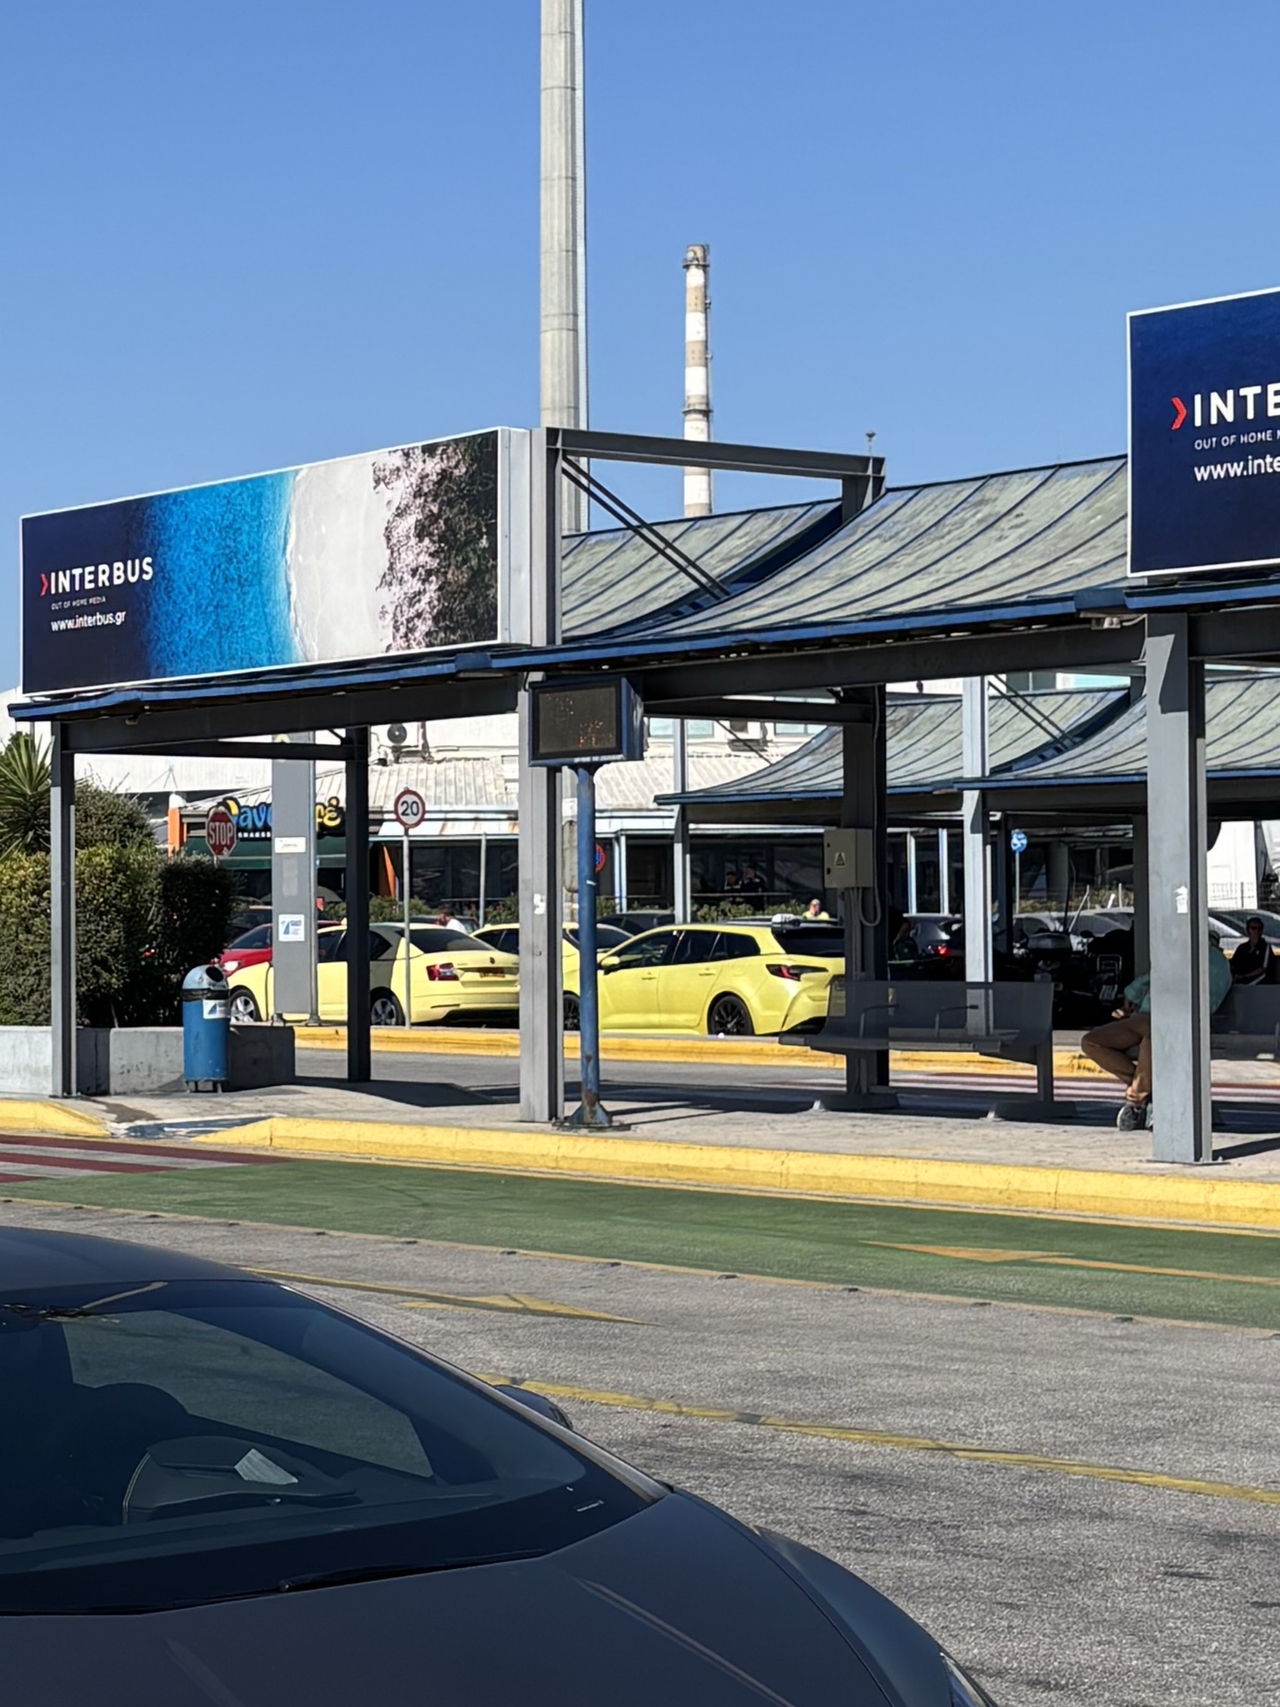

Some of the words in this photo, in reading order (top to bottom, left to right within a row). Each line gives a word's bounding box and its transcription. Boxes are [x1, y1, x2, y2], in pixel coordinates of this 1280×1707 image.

[1194, 437, 1216, 450] OUT
[1221, 434, 1237, 447] OF
[1240, 430, 1273, 443] HOME
[50, 556, 154, 595] INTERBUS
[50, 611, 127, 632] www.interbus.gr
[400, 800, 420, 816] 20
[208, 822, 234, 840] STOP
